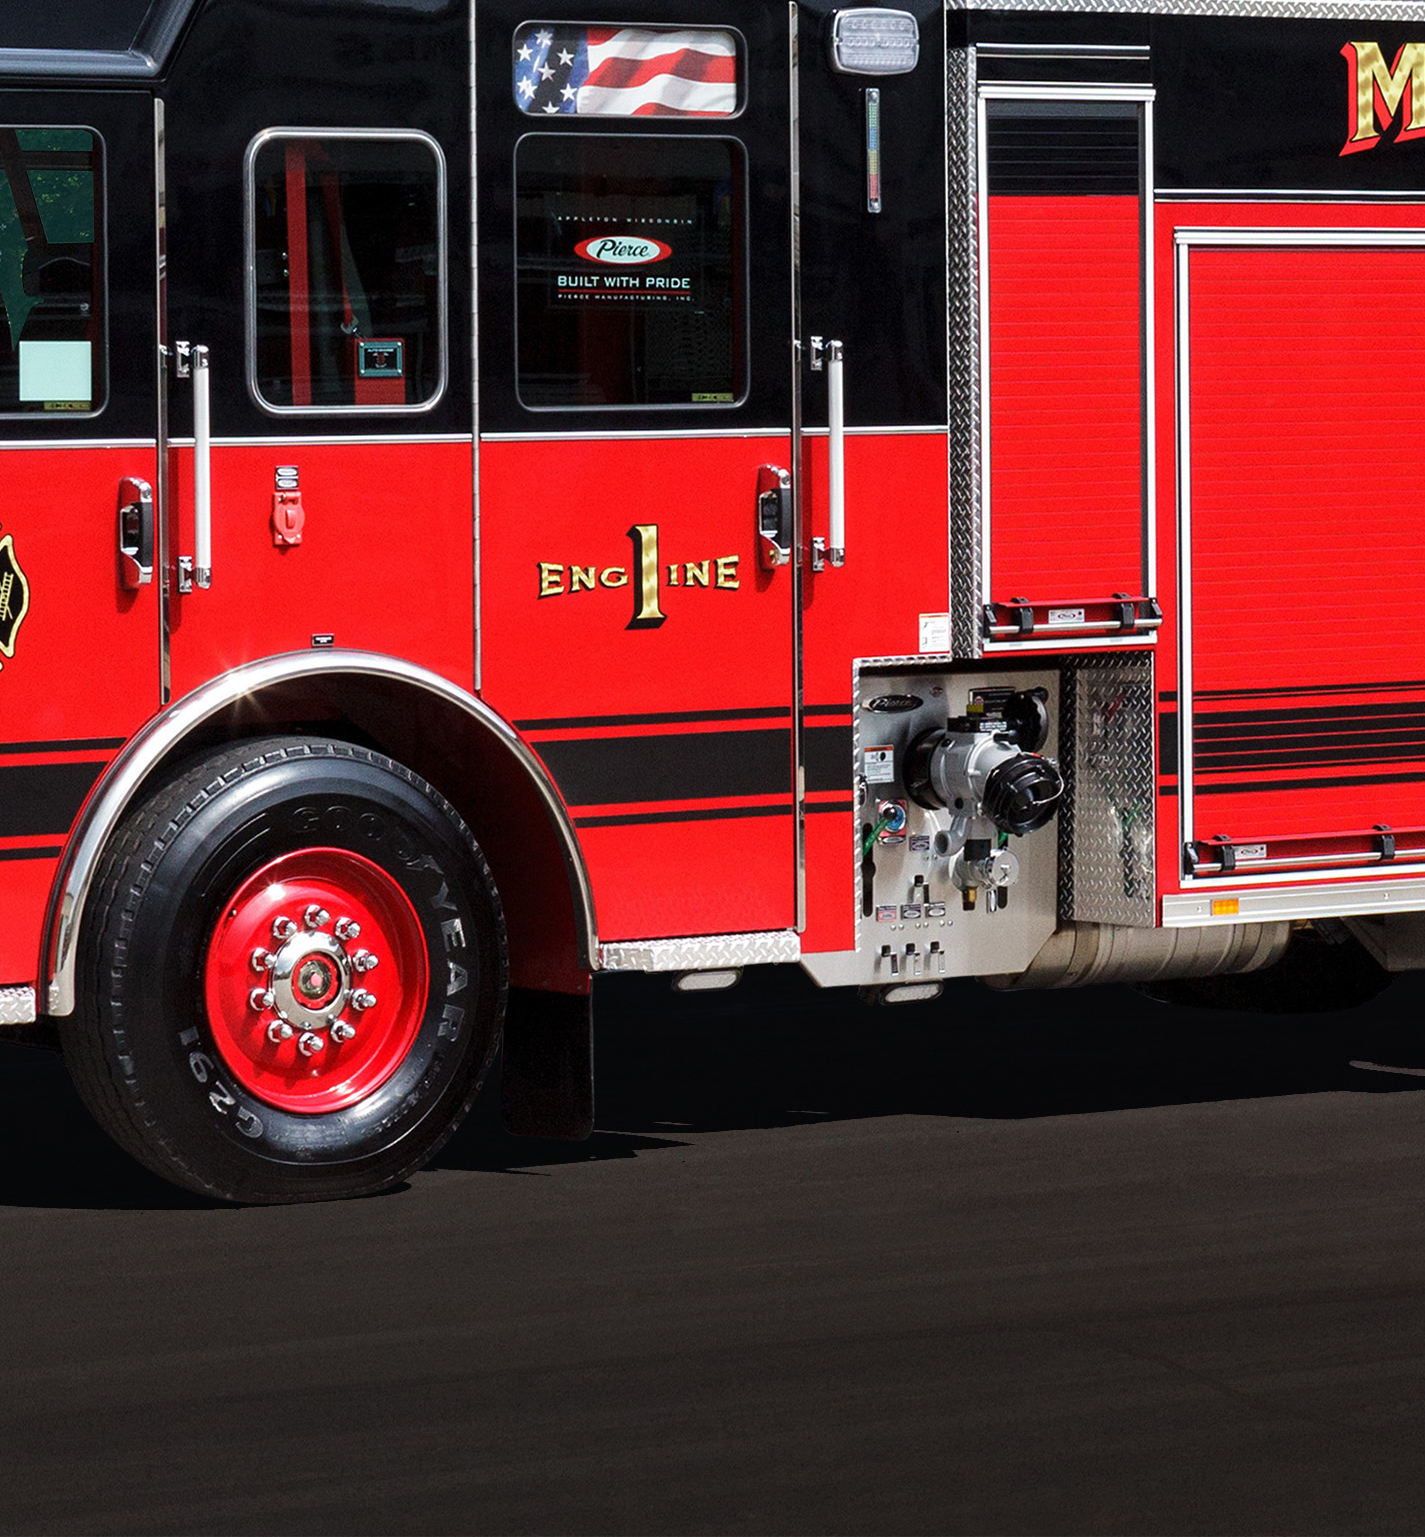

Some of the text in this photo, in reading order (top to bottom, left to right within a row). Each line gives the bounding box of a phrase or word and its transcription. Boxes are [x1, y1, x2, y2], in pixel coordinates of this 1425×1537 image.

[557, 215, 693, 225] APPLETON WISCONSIN
[595, 238, 650, 259] Pierce
[557, 275, 691, 289] BUILT WITH PRIDE
[290, 805, 469, 1042] GOODYEAR
[178, 1025, 265, 1140] G291
